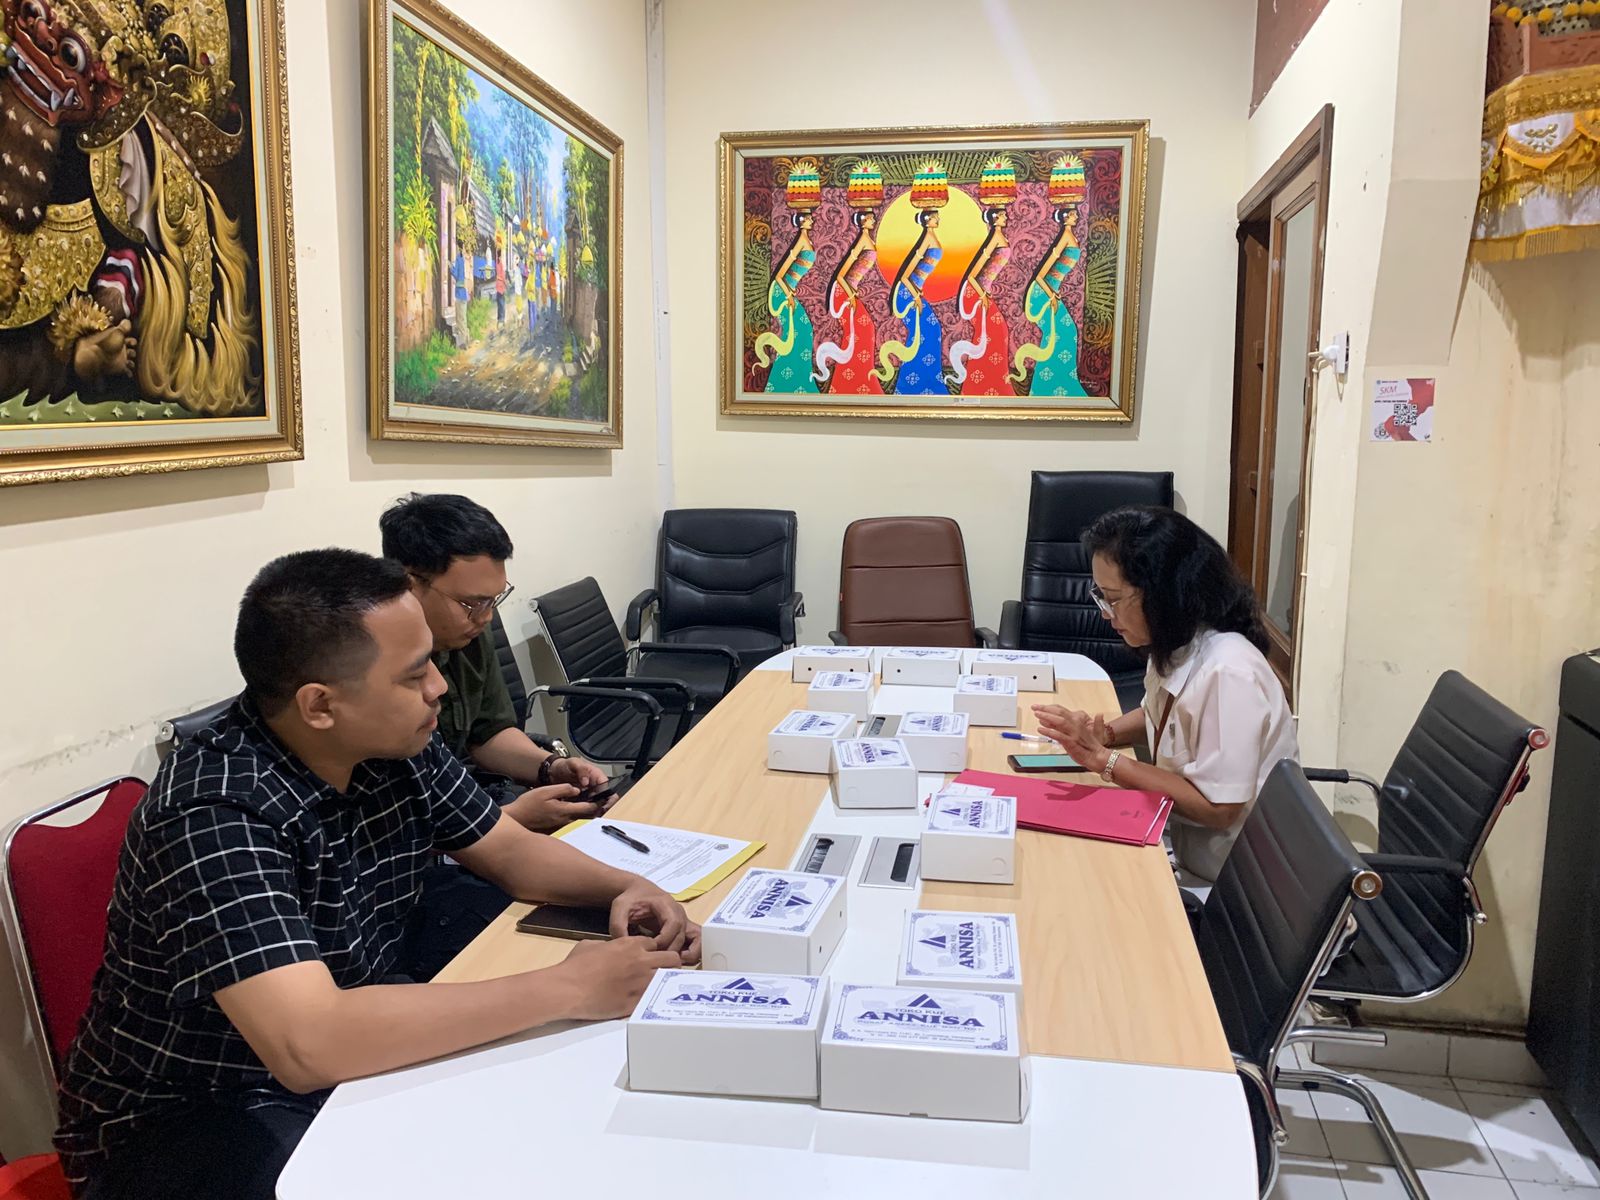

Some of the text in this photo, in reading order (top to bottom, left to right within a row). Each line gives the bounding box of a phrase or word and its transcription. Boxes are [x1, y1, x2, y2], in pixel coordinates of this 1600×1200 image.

[968, 800, 984, 829] ANNISA
[749, 878, 789, 919] ANNISA
[959, 921, 974, 969] ANNISA
[671, 993, 792, 1006] ANNISA
[856, 1011, 985, 1027] ANNISA
